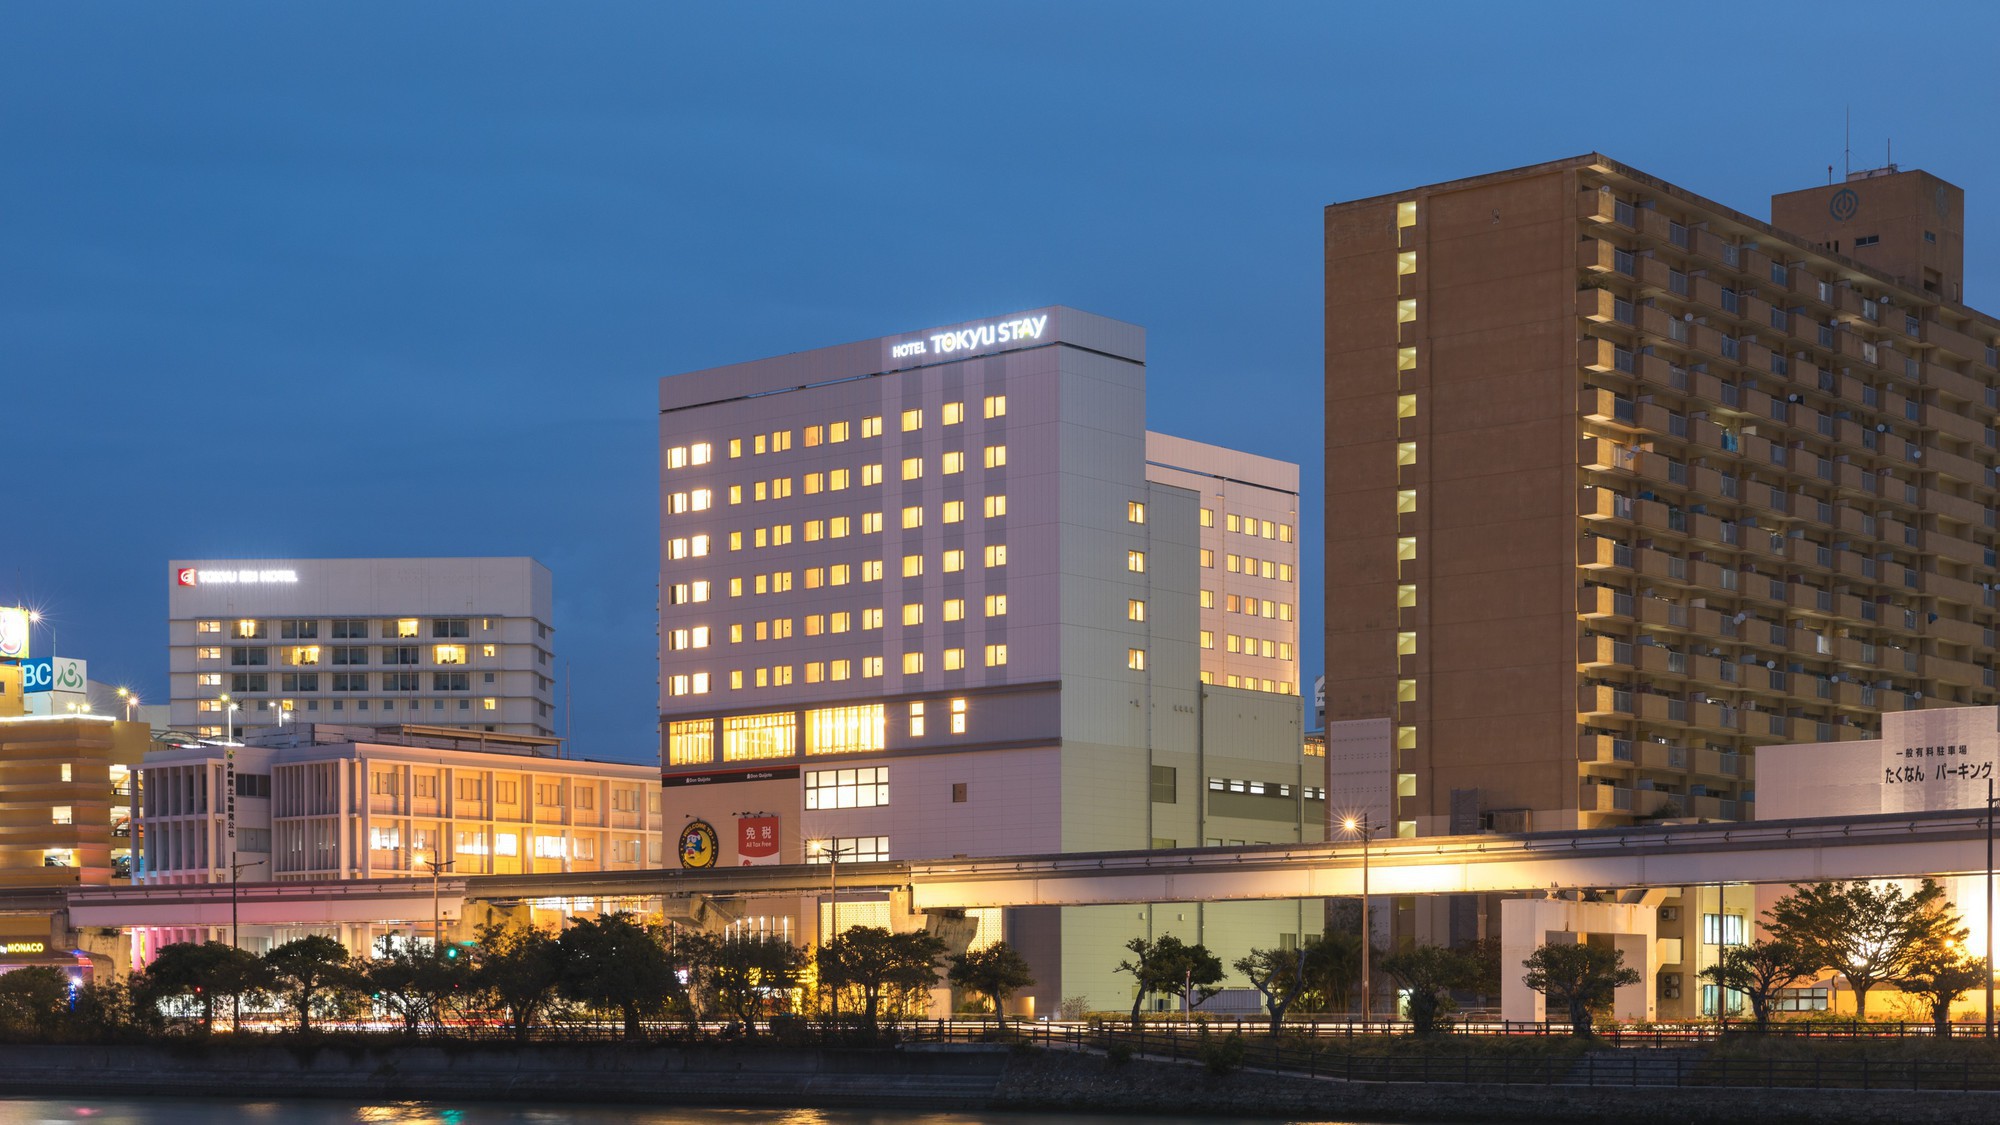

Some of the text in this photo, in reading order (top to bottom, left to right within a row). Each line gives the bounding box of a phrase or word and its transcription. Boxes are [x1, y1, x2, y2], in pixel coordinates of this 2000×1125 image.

[892, 315, 1048, 358] HOTEL TOKYU STAY
[1896, 745, 1968, 758] 一般有料駐車場
[1885, 761, 1994, 784] たくなん パーキング
[683, 822, 713, 837] WELCOME TO
[746, 826, 772, 839] 免税
[7, 942, 44, 953] MONACO
